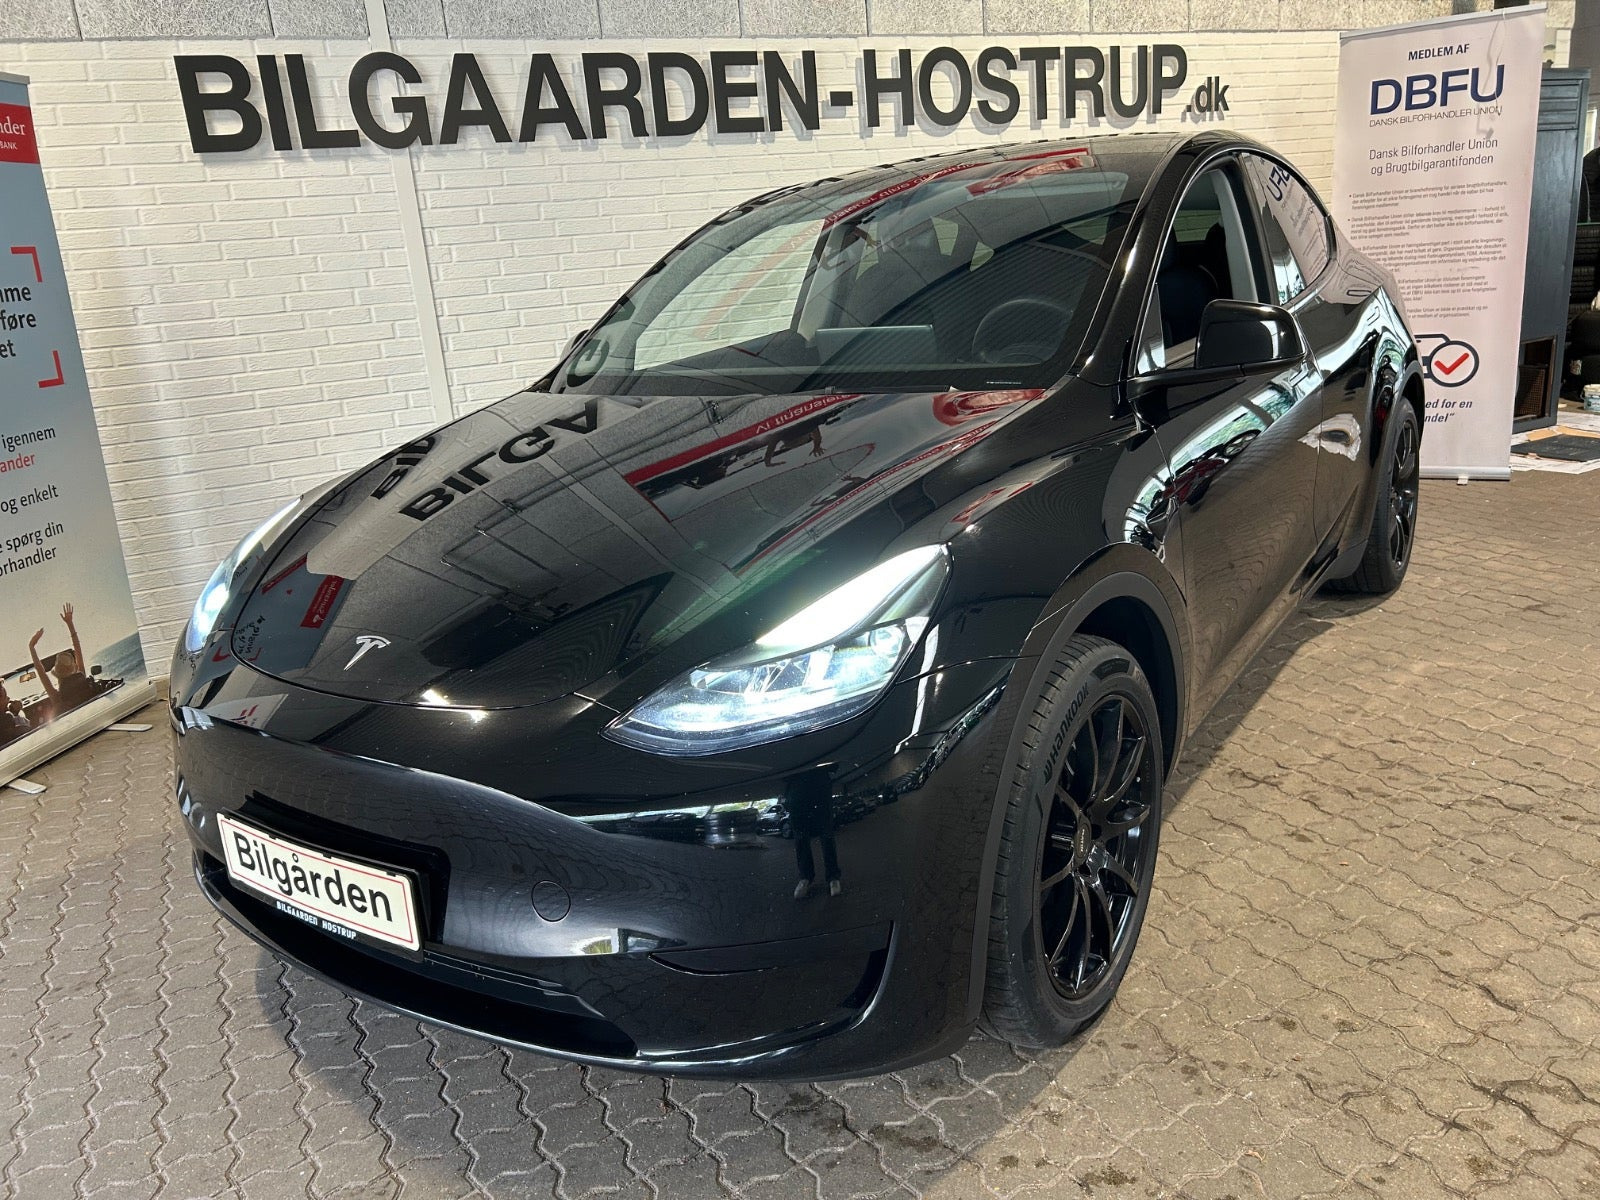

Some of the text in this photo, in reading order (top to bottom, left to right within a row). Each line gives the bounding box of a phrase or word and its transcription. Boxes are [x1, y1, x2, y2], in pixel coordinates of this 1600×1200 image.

[1408, 43, 1470, 61] MEDLEM AF
[1370, 64, 1505, 116] DBFU
[1369, 105, 1503, 128] DANSK BILFORHANDLER UNION
[1369, 138, 1498, 161] Dansk Bilforhandler Union
[1370, 154, 1494, 177] og Brugtbilgarantifonden
[0, 286, 32, 303] me
[1441, 398, 1457, 409] for
[1459, 400, 1473, 409] en
[1, 427, 57, 453] igennem
[0, 453, 36, 473] ander
[0, 484, 59, 515] og enkelt
[6, 530, 43, 553] spørg
[44, 522, 64, 538] din
[233, 830, 393, 923] Bilgården
[276, 900, 358, 940] BILGAARDEN HOSTRUP
